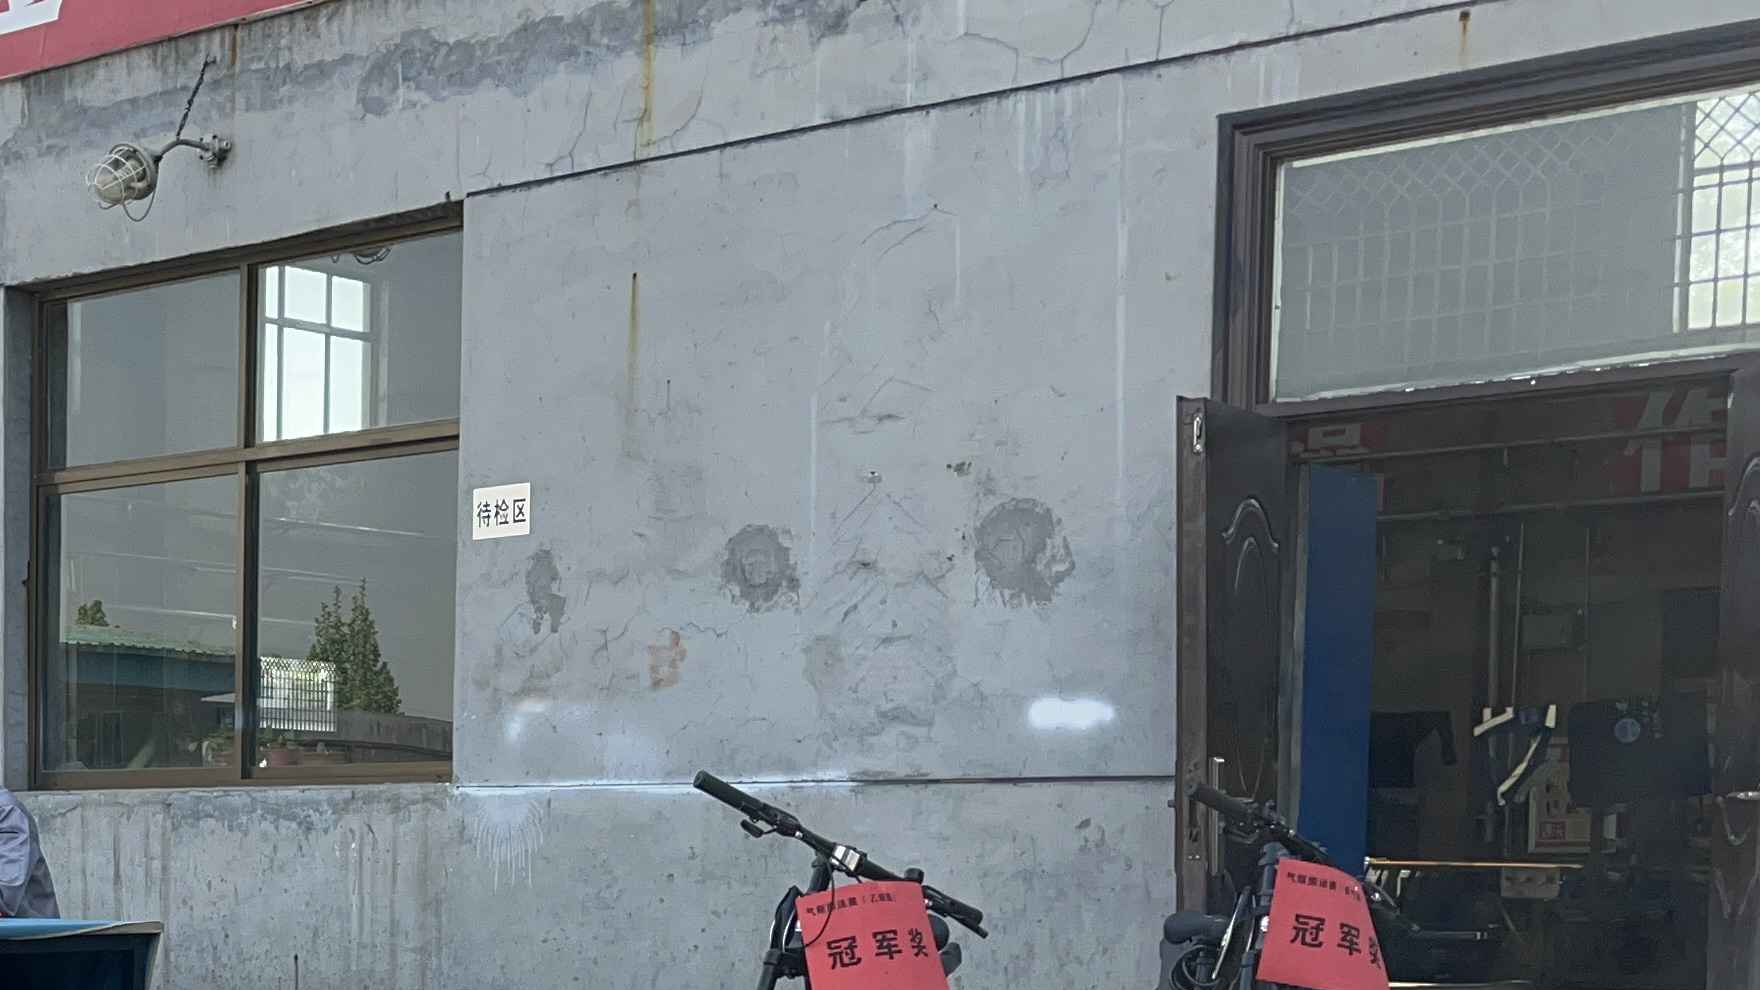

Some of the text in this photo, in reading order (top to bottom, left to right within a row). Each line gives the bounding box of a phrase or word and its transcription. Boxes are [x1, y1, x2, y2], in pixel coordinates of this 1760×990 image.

[476, 498, 527, 528] 待检区
[826, 927, 929, 970] 冠军奖
